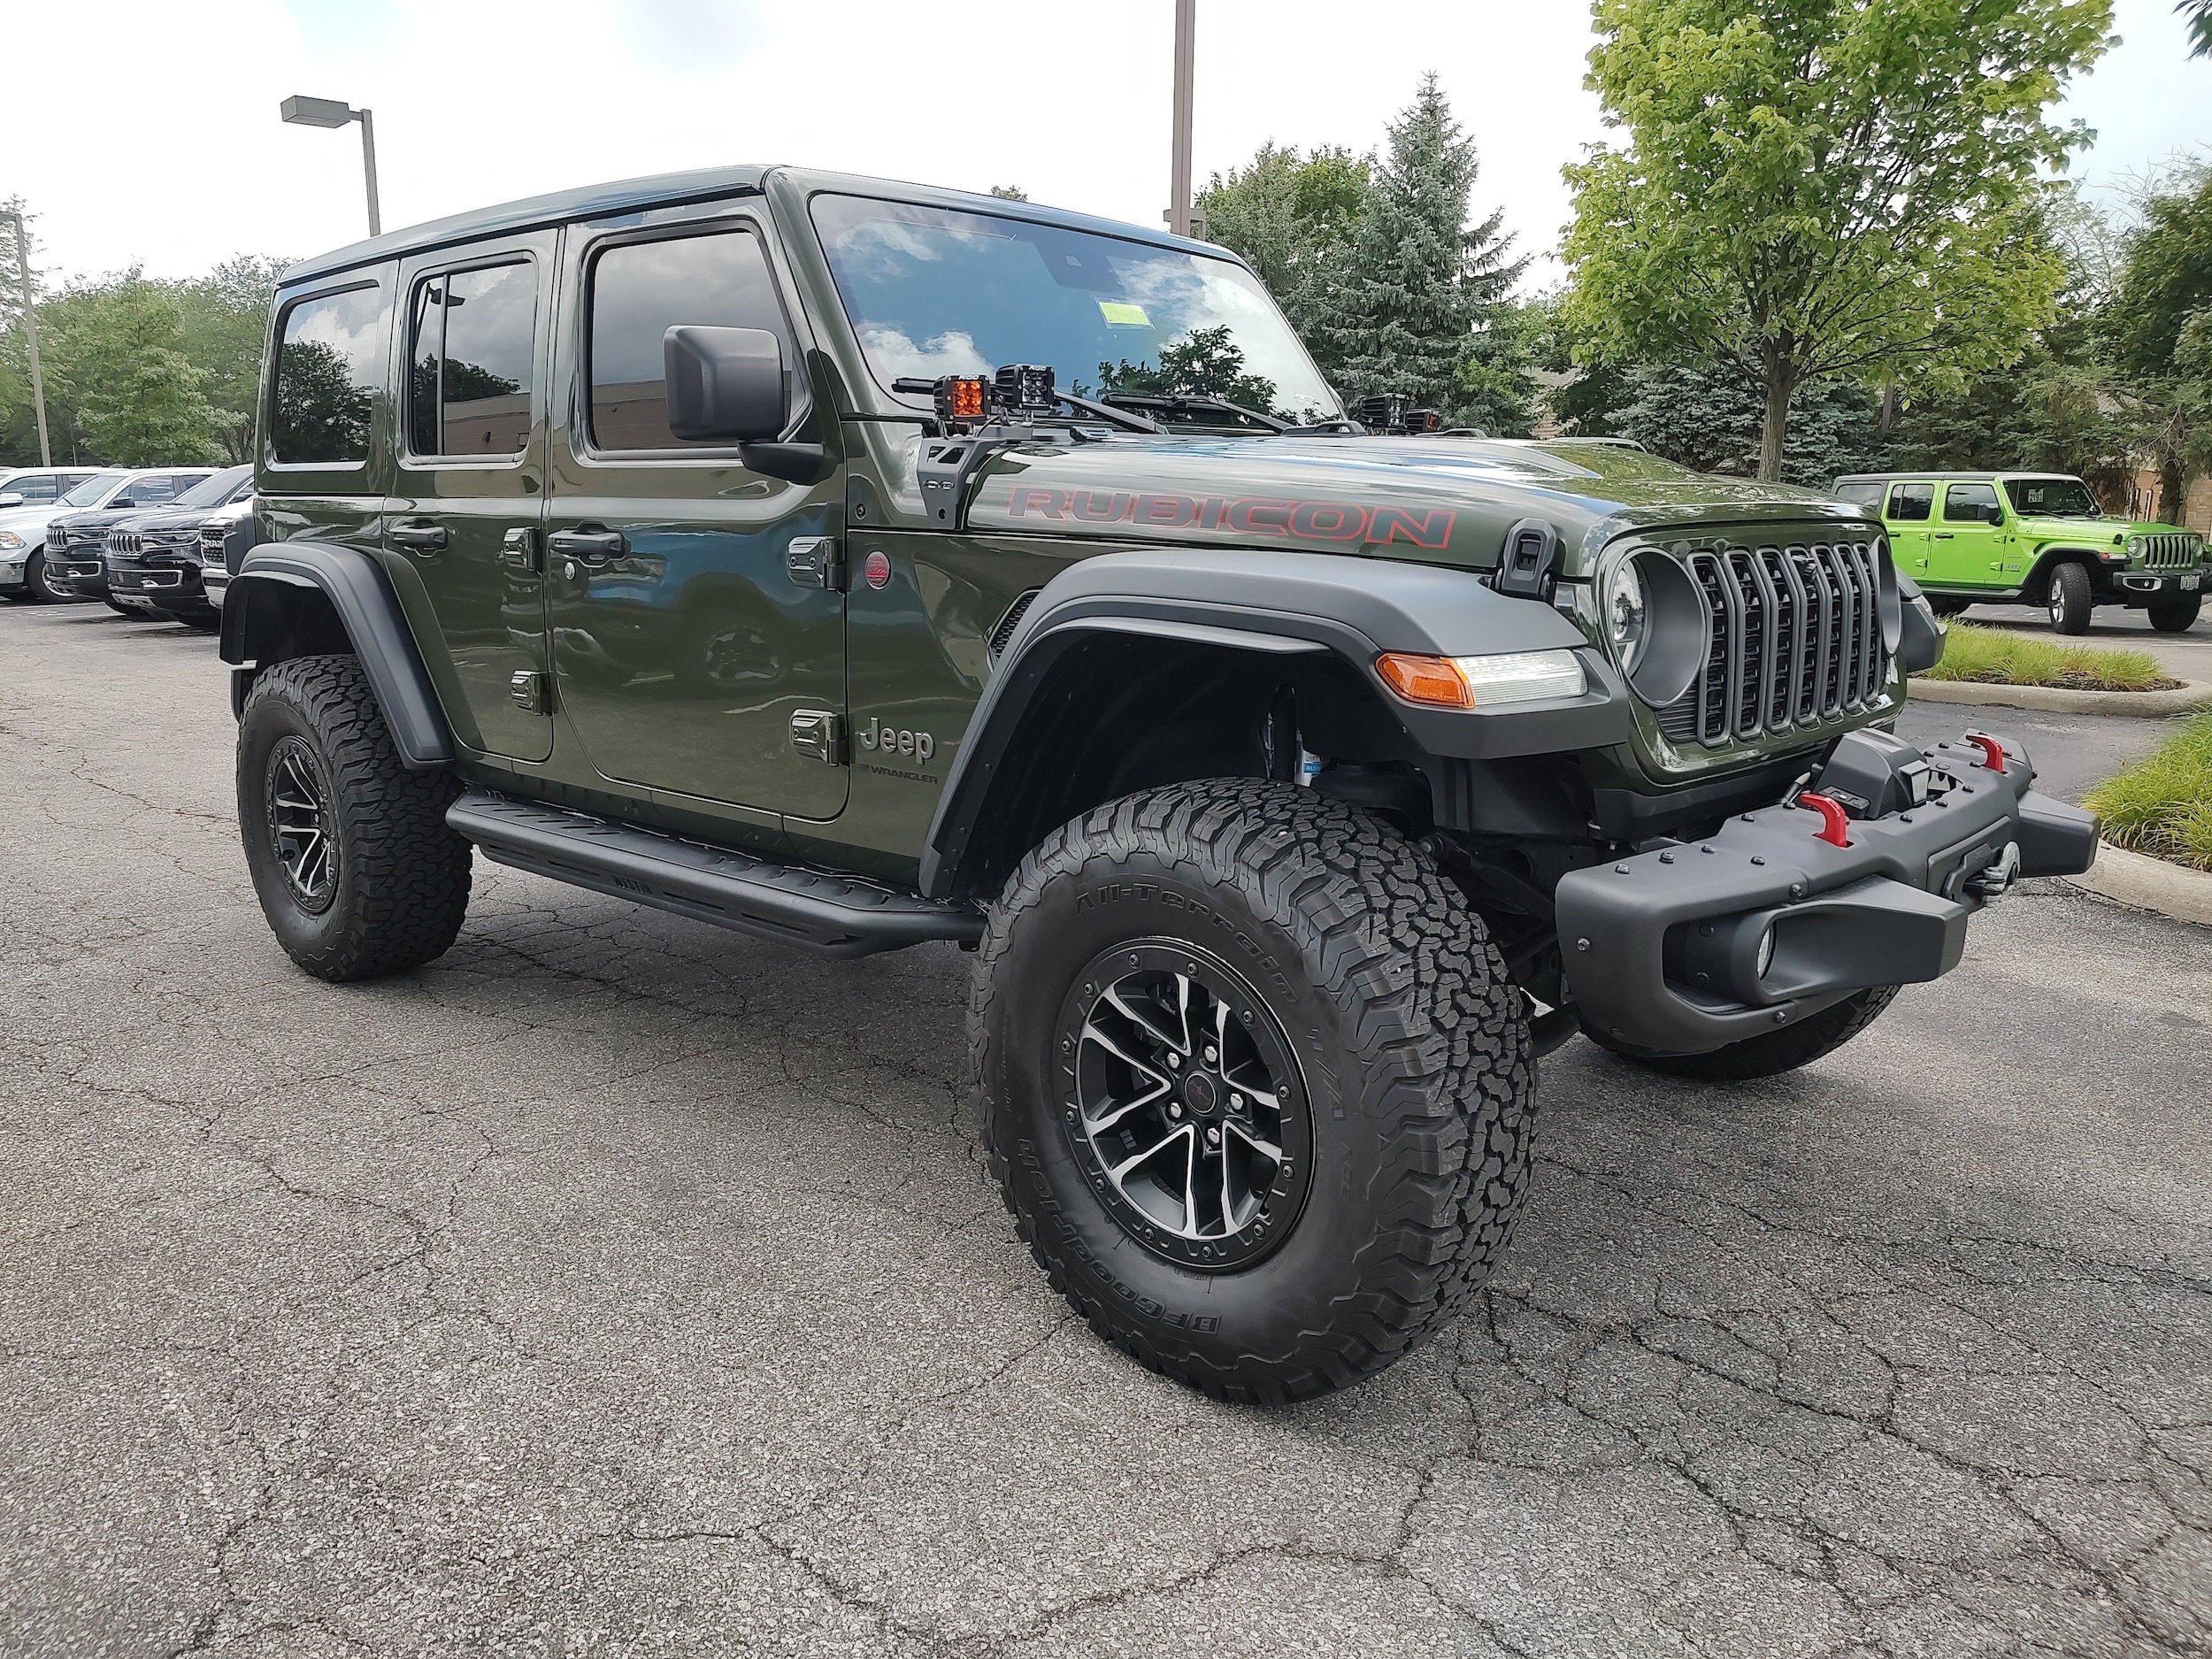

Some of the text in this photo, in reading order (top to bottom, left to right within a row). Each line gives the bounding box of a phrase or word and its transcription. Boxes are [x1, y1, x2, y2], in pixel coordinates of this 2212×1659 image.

[1007, 487, 1457, 549] RUBICON
[860, 717, 935, 765] Jeep
[871, 764, 939, 785] WRANGLER
[1076, 882, 1299, 1005] All-Terrain
